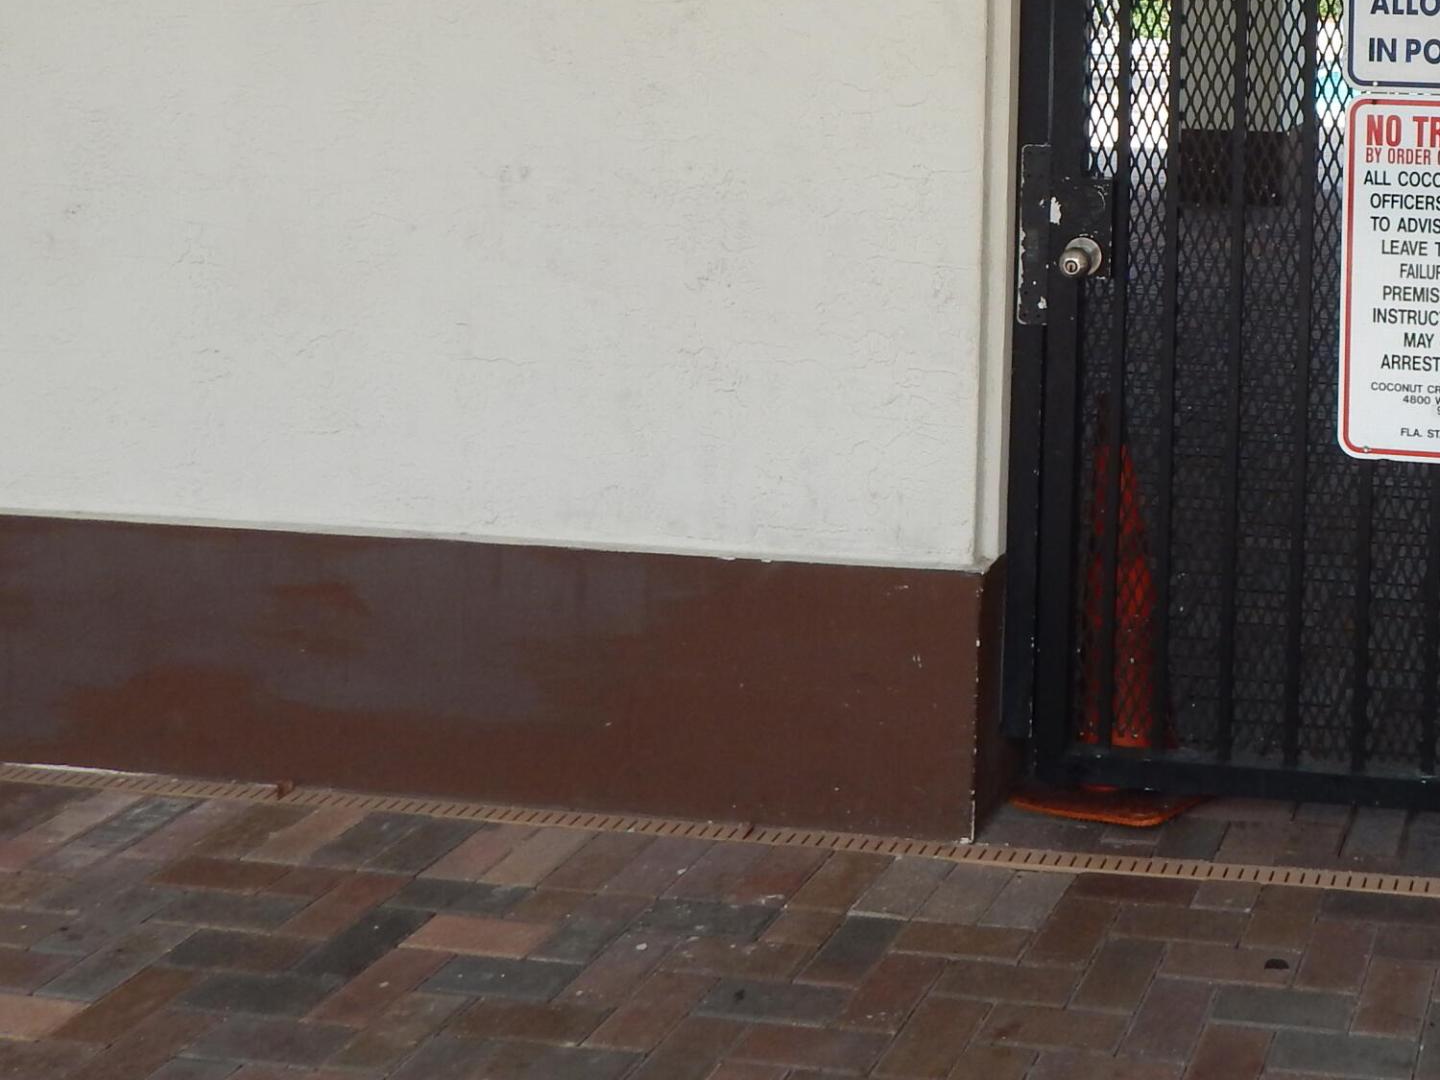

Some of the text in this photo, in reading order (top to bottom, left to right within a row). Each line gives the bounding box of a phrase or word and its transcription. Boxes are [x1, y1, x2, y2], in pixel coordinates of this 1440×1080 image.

[1369, 38, 1397, 62] IN
[1366, 114, 1400, 146] NO
[1366, 148, 1381, 163] BY
[1387, 149, 1431, 165] ORDER
[1364, 171, 1391, 186] ALL
[1370, 217, 1390, 231] TO
[1381, 240, 1428, 256] LEAVE
[1403, 333, 1434, 348] MAY
[1381, 355, 1440, 371] ARREST
[1371, 382, 1423, 393] COCONUT
[1403, 395, 1430, 405] 4800
[1400, 428, 1421, 438] FLA.
